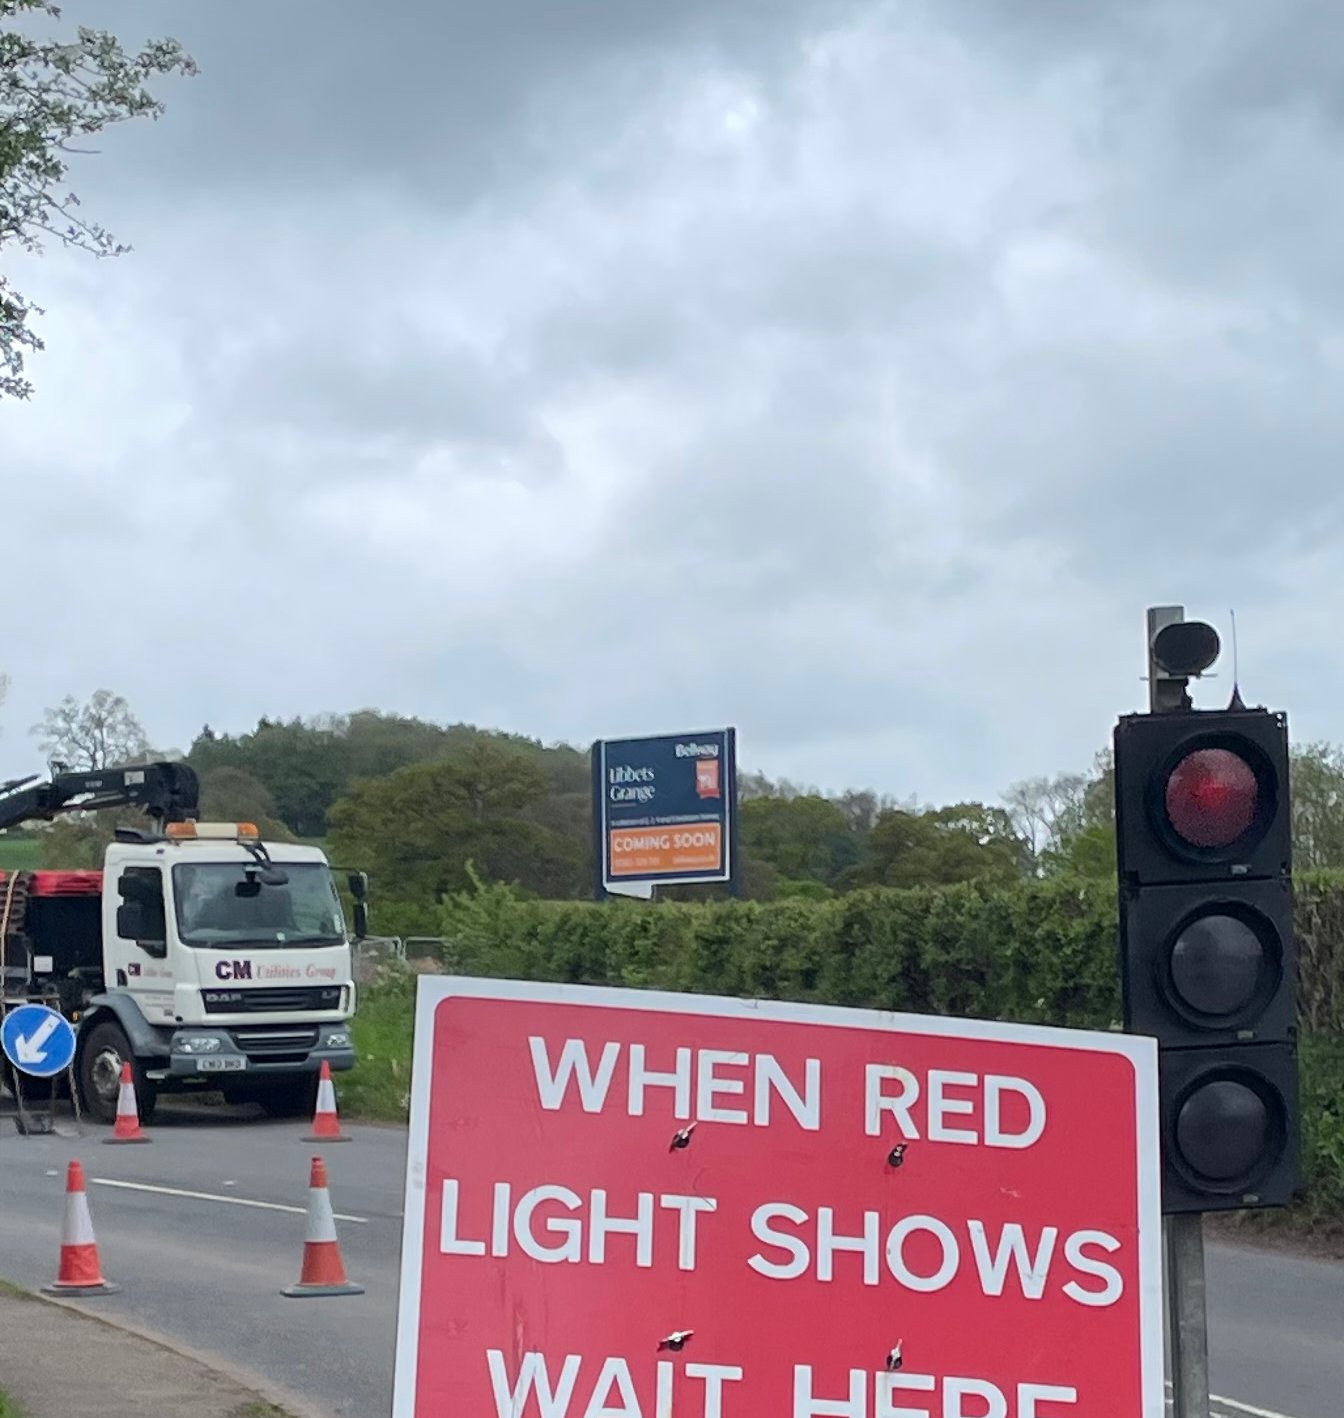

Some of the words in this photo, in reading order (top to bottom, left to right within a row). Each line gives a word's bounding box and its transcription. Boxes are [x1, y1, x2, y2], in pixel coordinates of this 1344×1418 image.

[609, 785, 656, 803] Grange
[614, 835, 670, 852] COMING
[672, 832, 715, 848] SOON
[215, 960, 253, 980] CM
[528, 1036, 821, 1131] WHEN
[864, 1063, 1047, 1149] RED
[439, 1179, 717, 1271] LIGHT
[747, 1202, 1124, 1307] SHOWS
